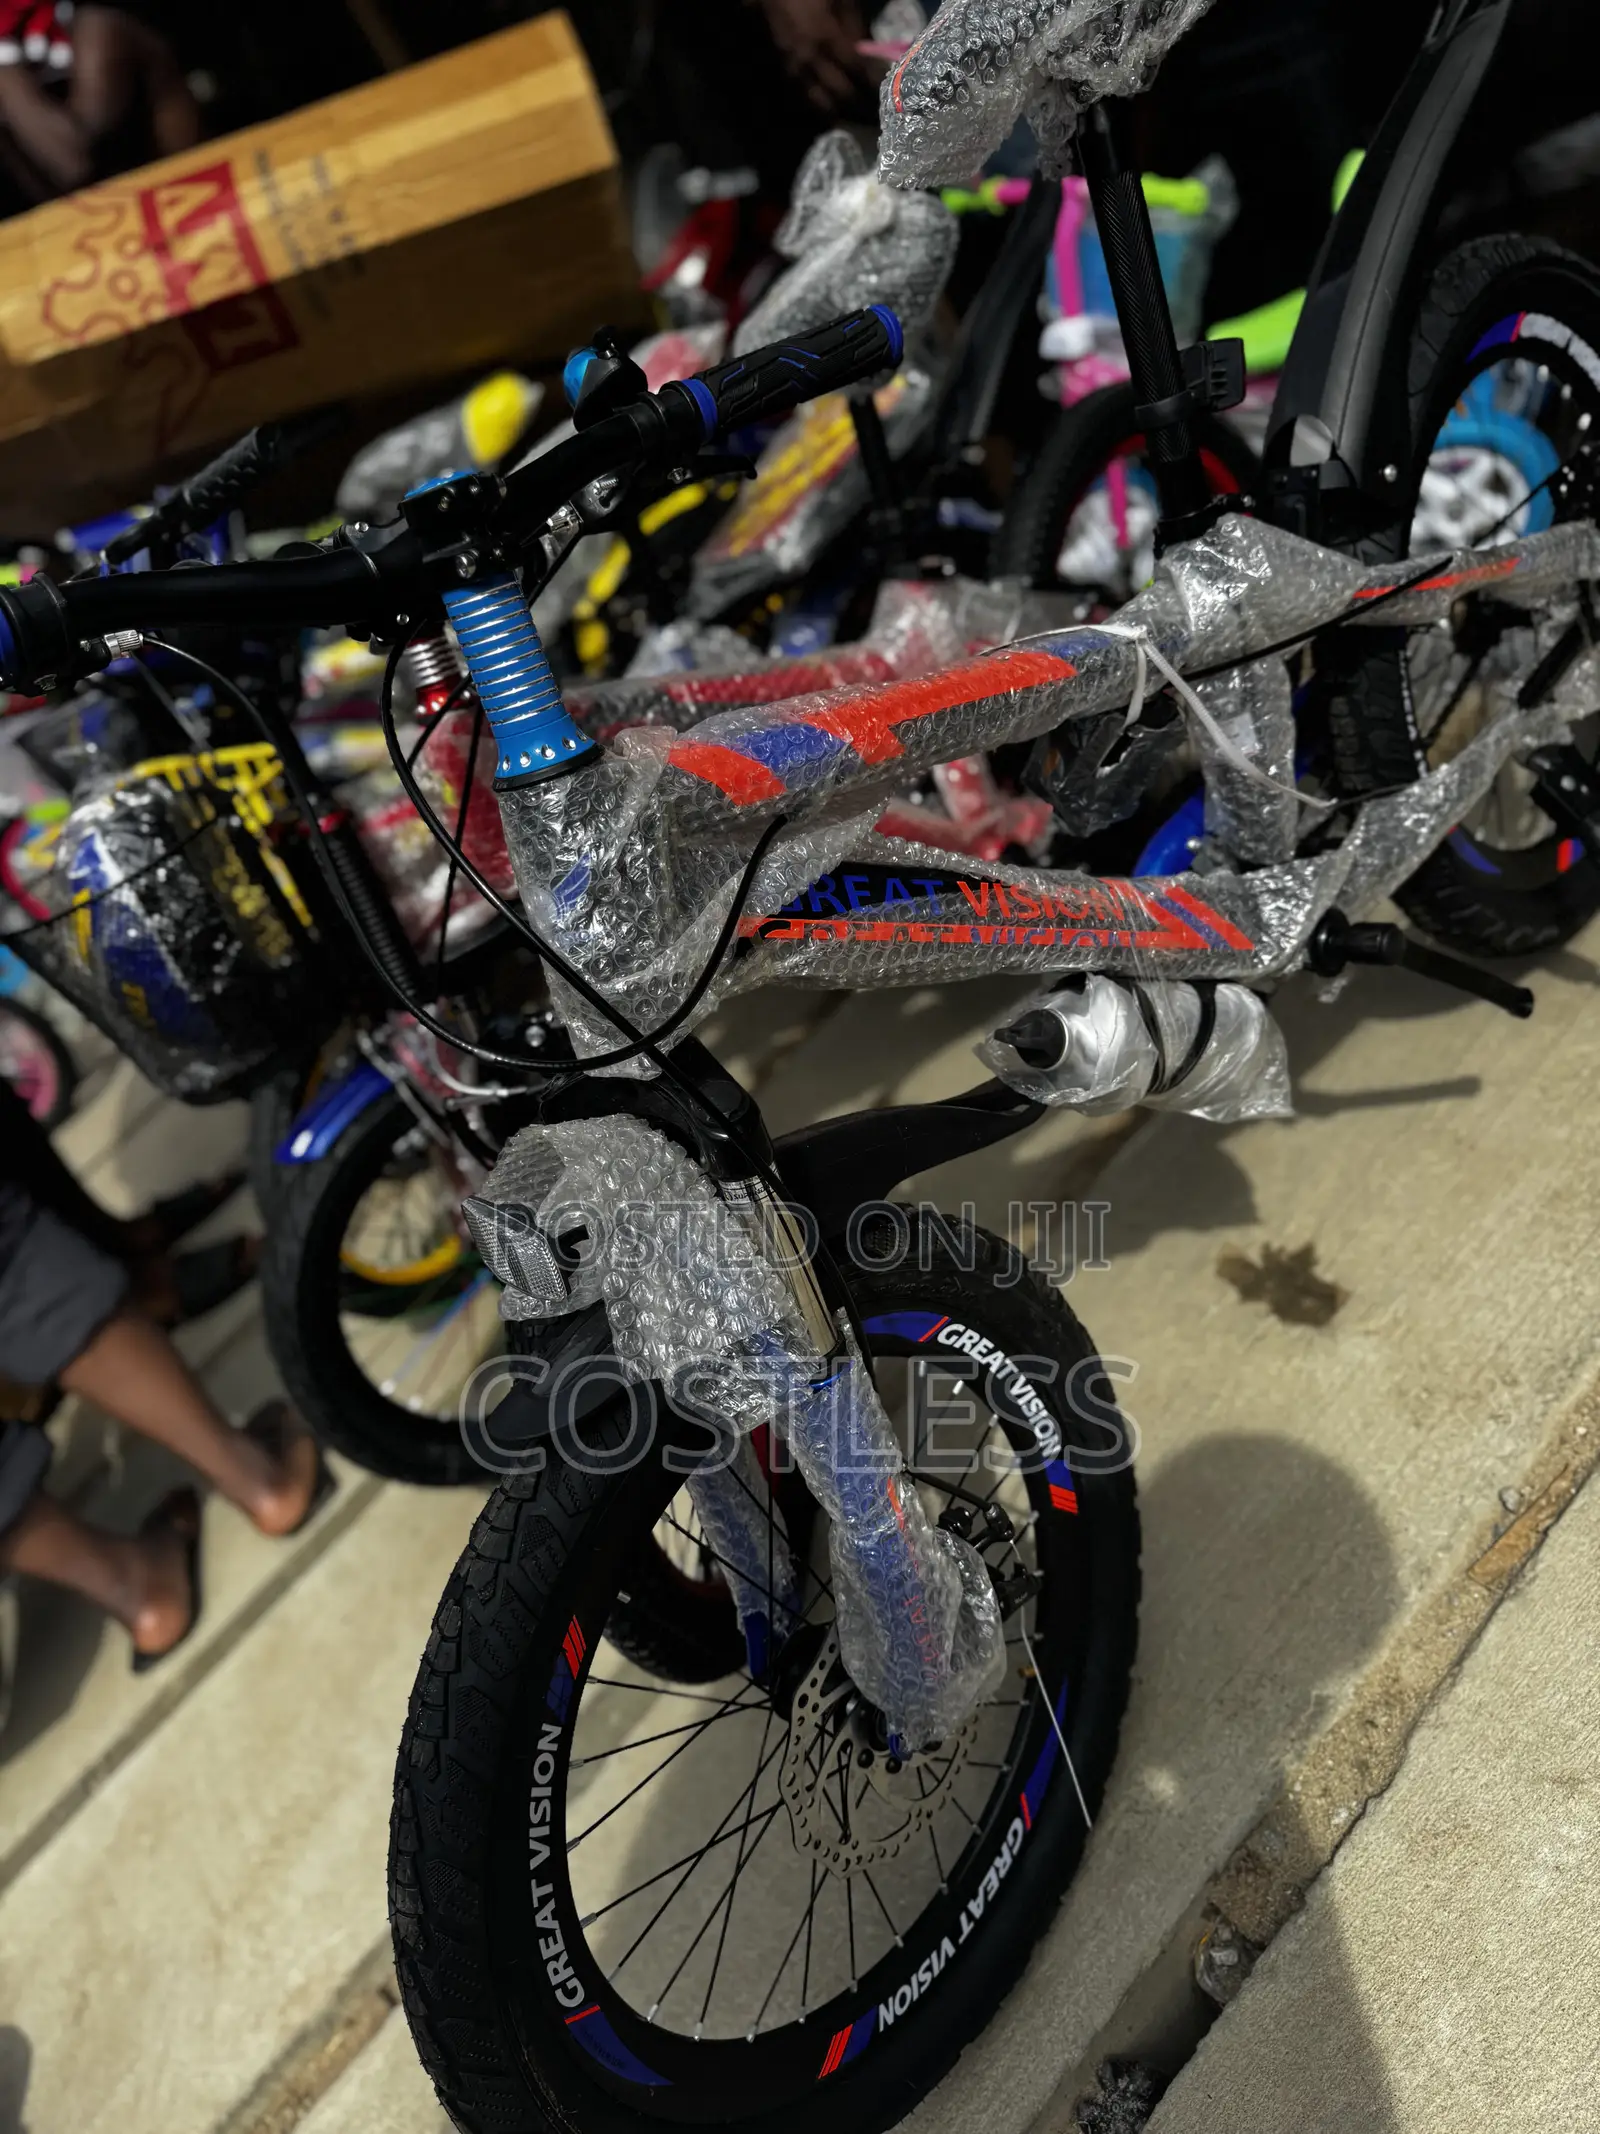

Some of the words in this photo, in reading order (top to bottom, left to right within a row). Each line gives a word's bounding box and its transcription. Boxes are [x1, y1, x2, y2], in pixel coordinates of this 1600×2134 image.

[957, 880, 1125, 921] VISION
[937, 1323, 1019, 1380] GREAT
[1009, 1374, 1062, 1457] VISION
[529, 1723, 562, 1871] VISION
[531, 1879, 585, 2008] GREAT
[958, 1817, 1024, 1945] GREAT
[878, 1936, 956, 2033] VISION
